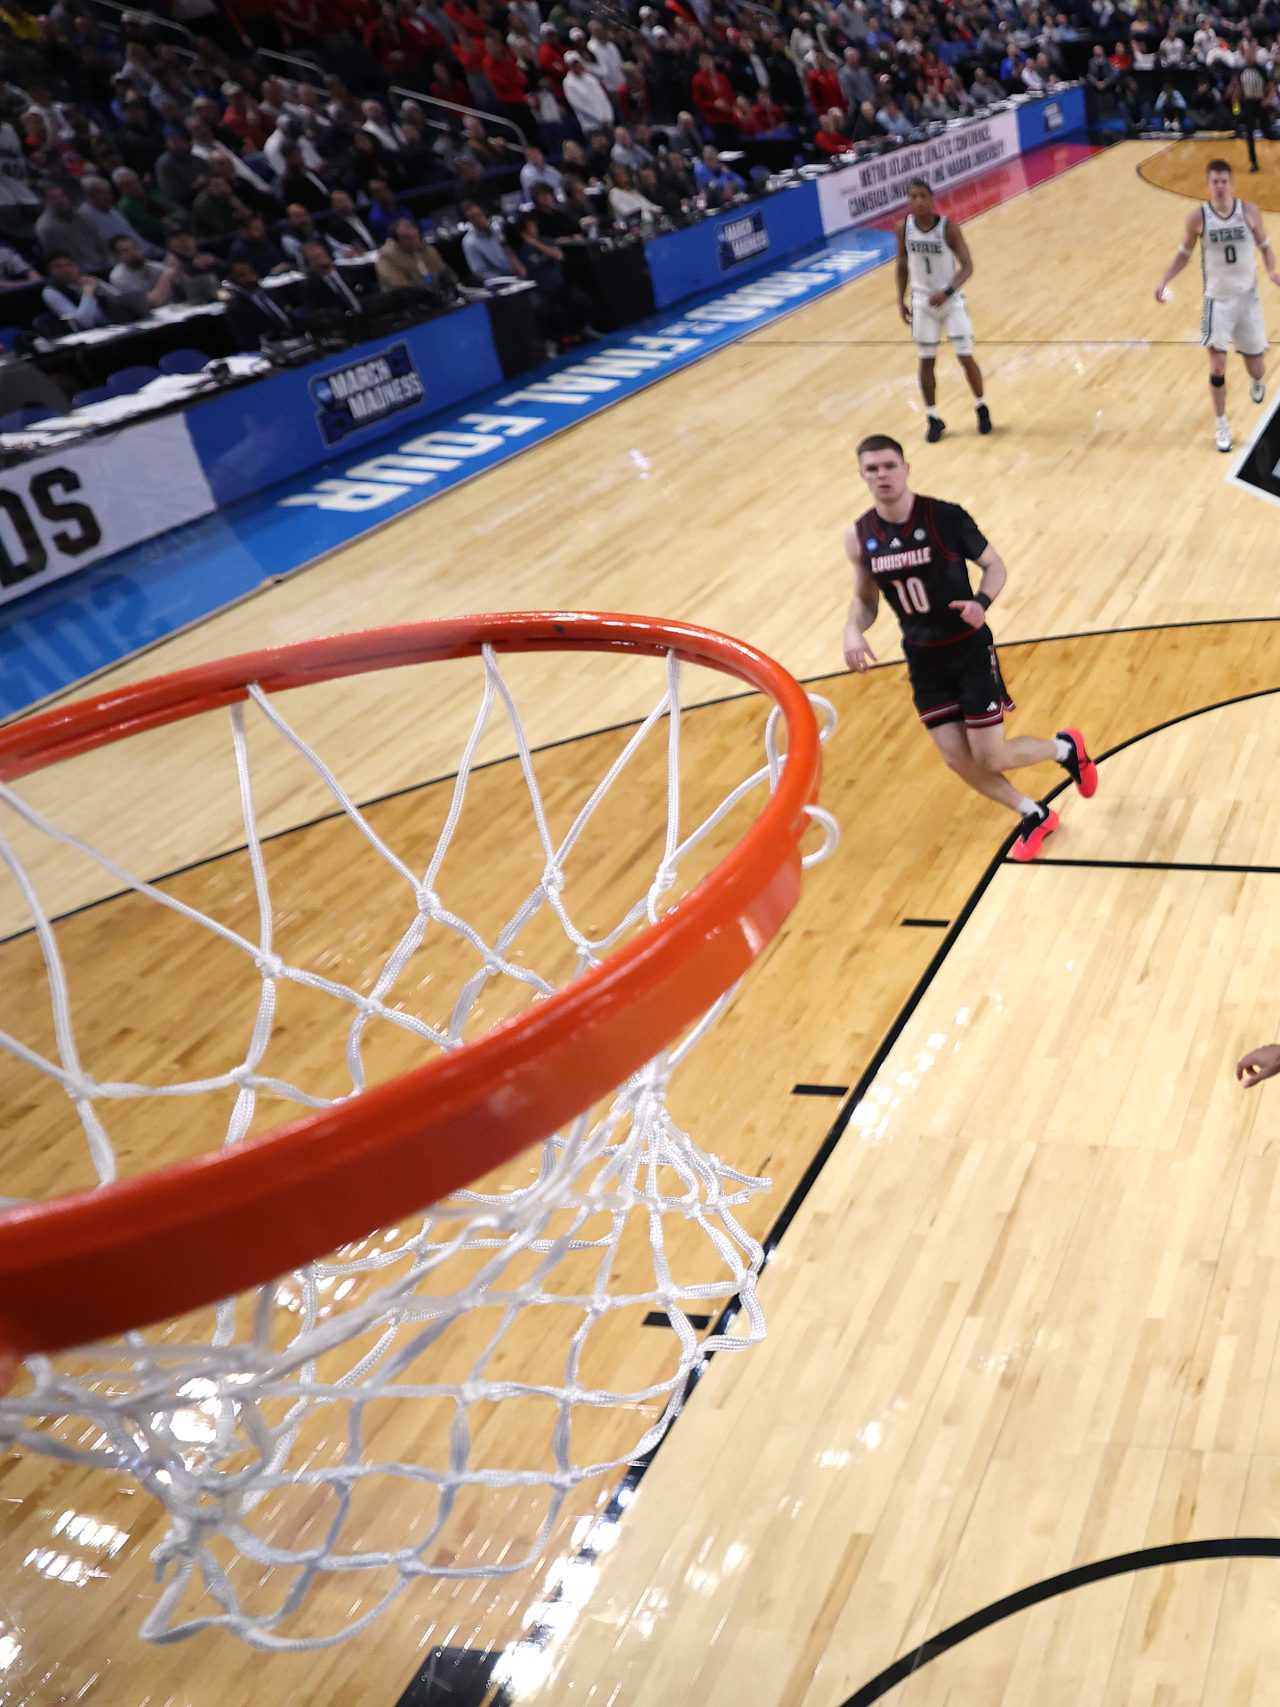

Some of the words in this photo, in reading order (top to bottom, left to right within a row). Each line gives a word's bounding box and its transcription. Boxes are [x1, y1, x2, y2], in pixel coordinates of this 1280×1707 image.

[923, 256, 931, 274] 1
[1225, 244, 1236, 264] 0
[328, 358, 392, 400] MARCH
[277, 413, 546, 513] FOUR
[871, 546, 932, 573] LOUISVILLE
[889, 576, 931, 614] 10
